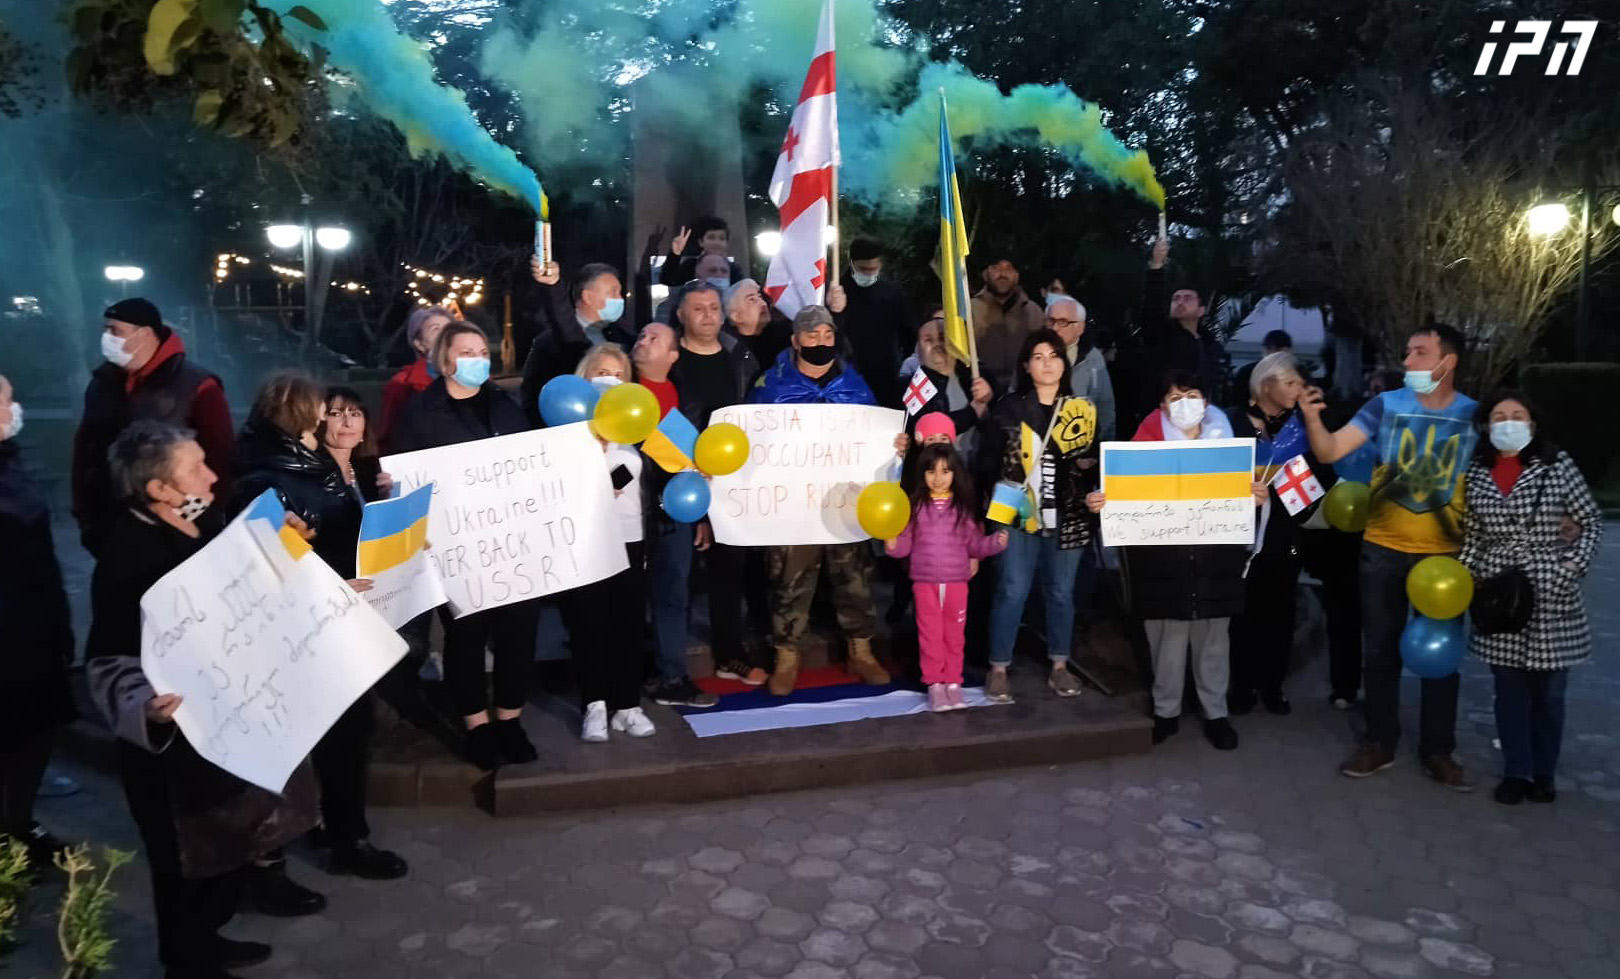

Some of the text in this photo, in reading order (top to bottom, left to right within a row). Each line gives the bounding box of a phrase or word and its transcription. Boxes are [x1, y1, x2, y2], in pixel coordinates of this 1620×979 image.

[463, 442, 552, 488] support
[751, 441, 867, 468] OCCUPANT
[726, 484, 789, 518] STOP
[477, 530, 532, 569] BACK
[544, 516, 577, 548] TO
[1141, 526, 1191, 541] support
